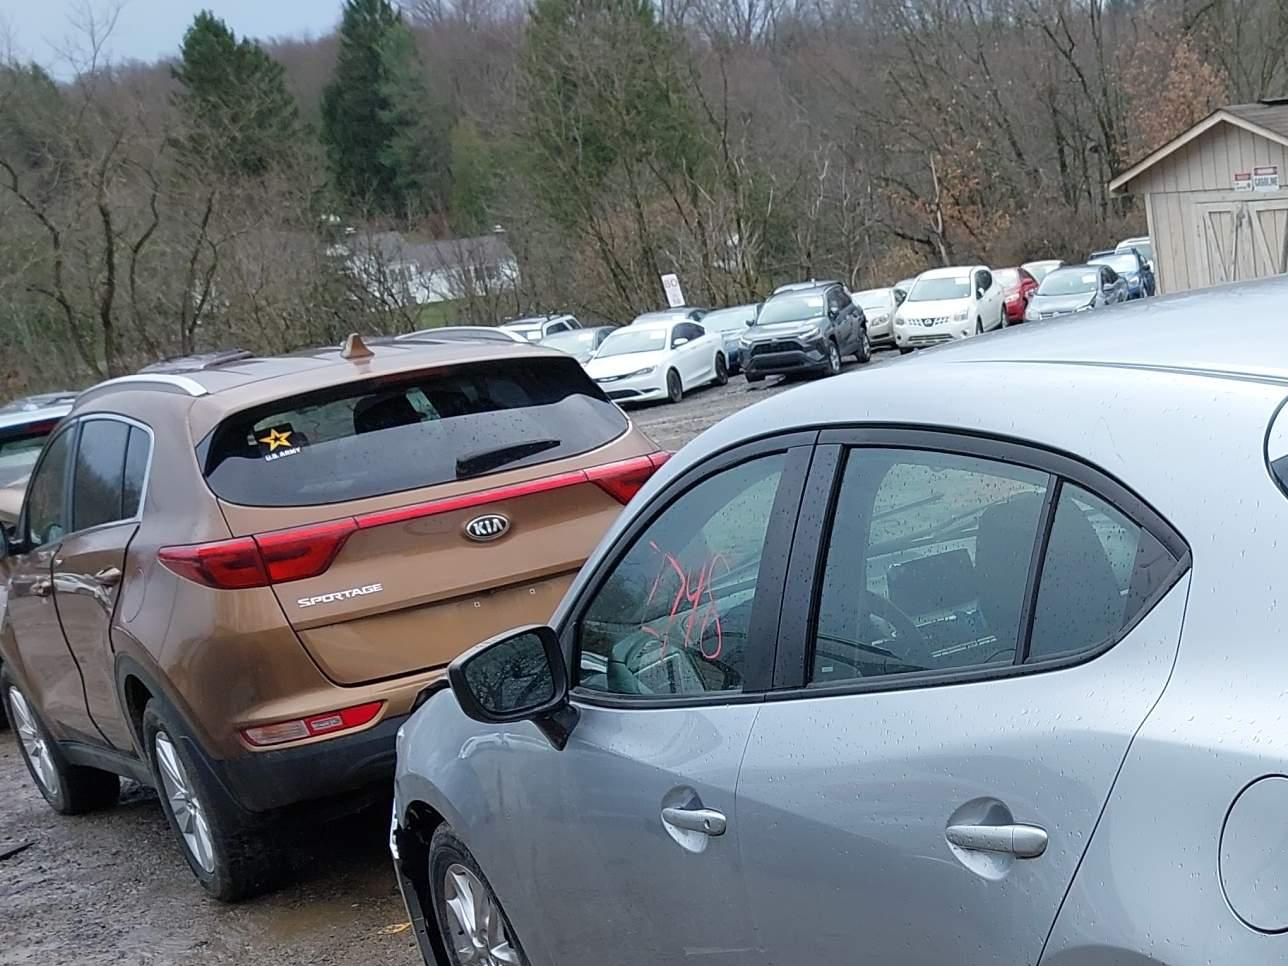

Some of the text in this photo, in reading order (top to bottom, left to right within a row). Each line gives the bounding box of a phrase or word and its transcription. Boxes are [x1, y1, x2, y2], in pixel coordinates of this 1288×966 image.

[279, 447, 301, 458] ARMY
[473, 518, 504, 536] KIA
[297, 583, 384, 608] SPORTAGE
